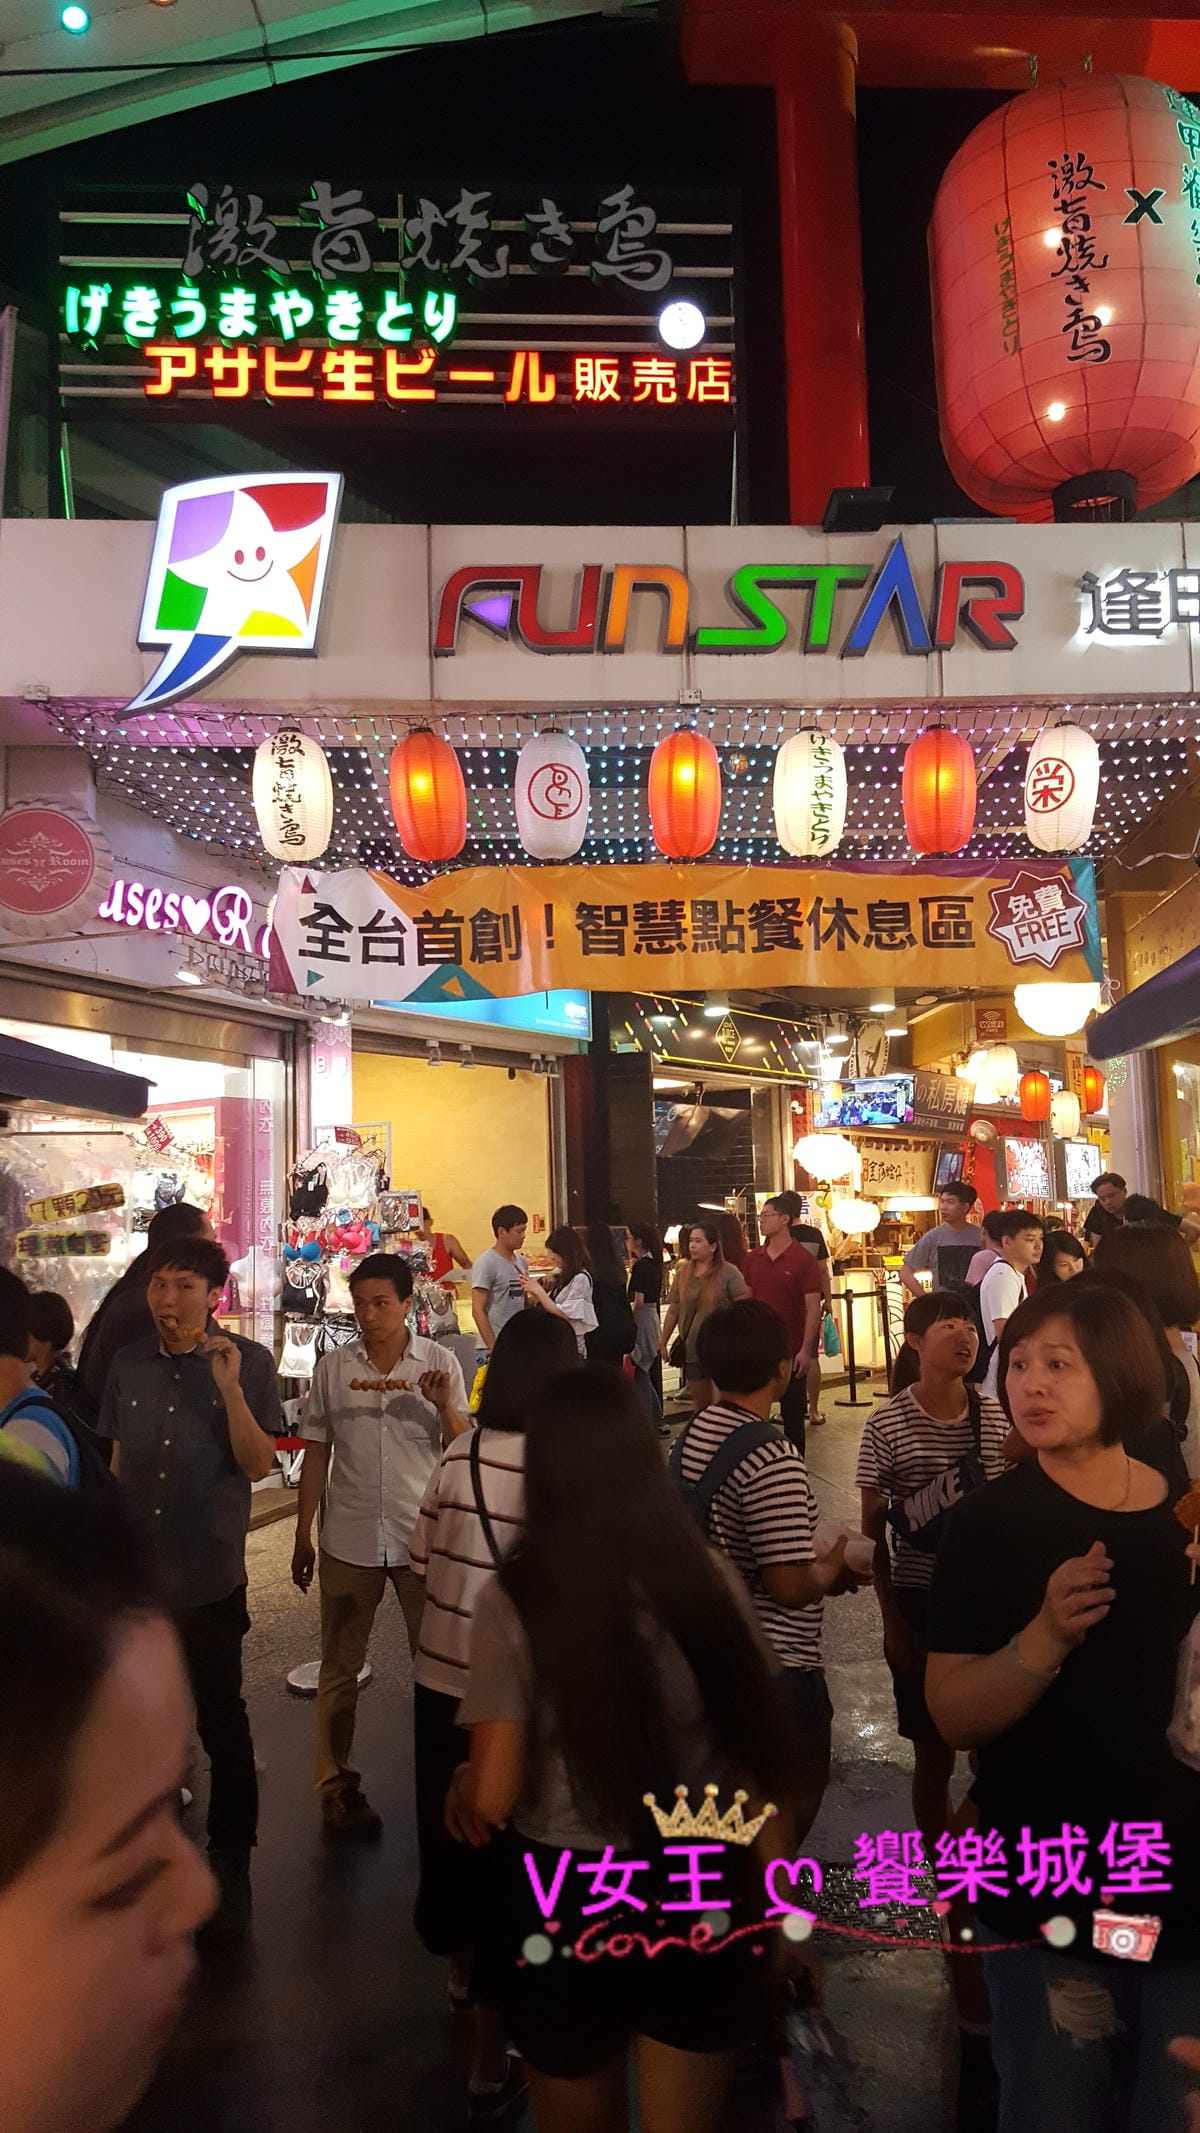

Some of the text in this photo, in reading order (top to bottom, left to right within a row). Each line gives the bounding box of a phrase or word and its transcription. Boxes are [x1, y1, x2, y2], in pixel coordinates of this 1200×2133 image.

[183, 182, 675, 292] 激旨焼き鳥
[66, 283, 457, 343] げきうまやきとり
[694, 535, 1026, 656] STAR
[1007, 884, 1065, 923] 免費
[1017, 913, 1073, 949] FREE
[904, 1466, 964, 1532] NIKE
